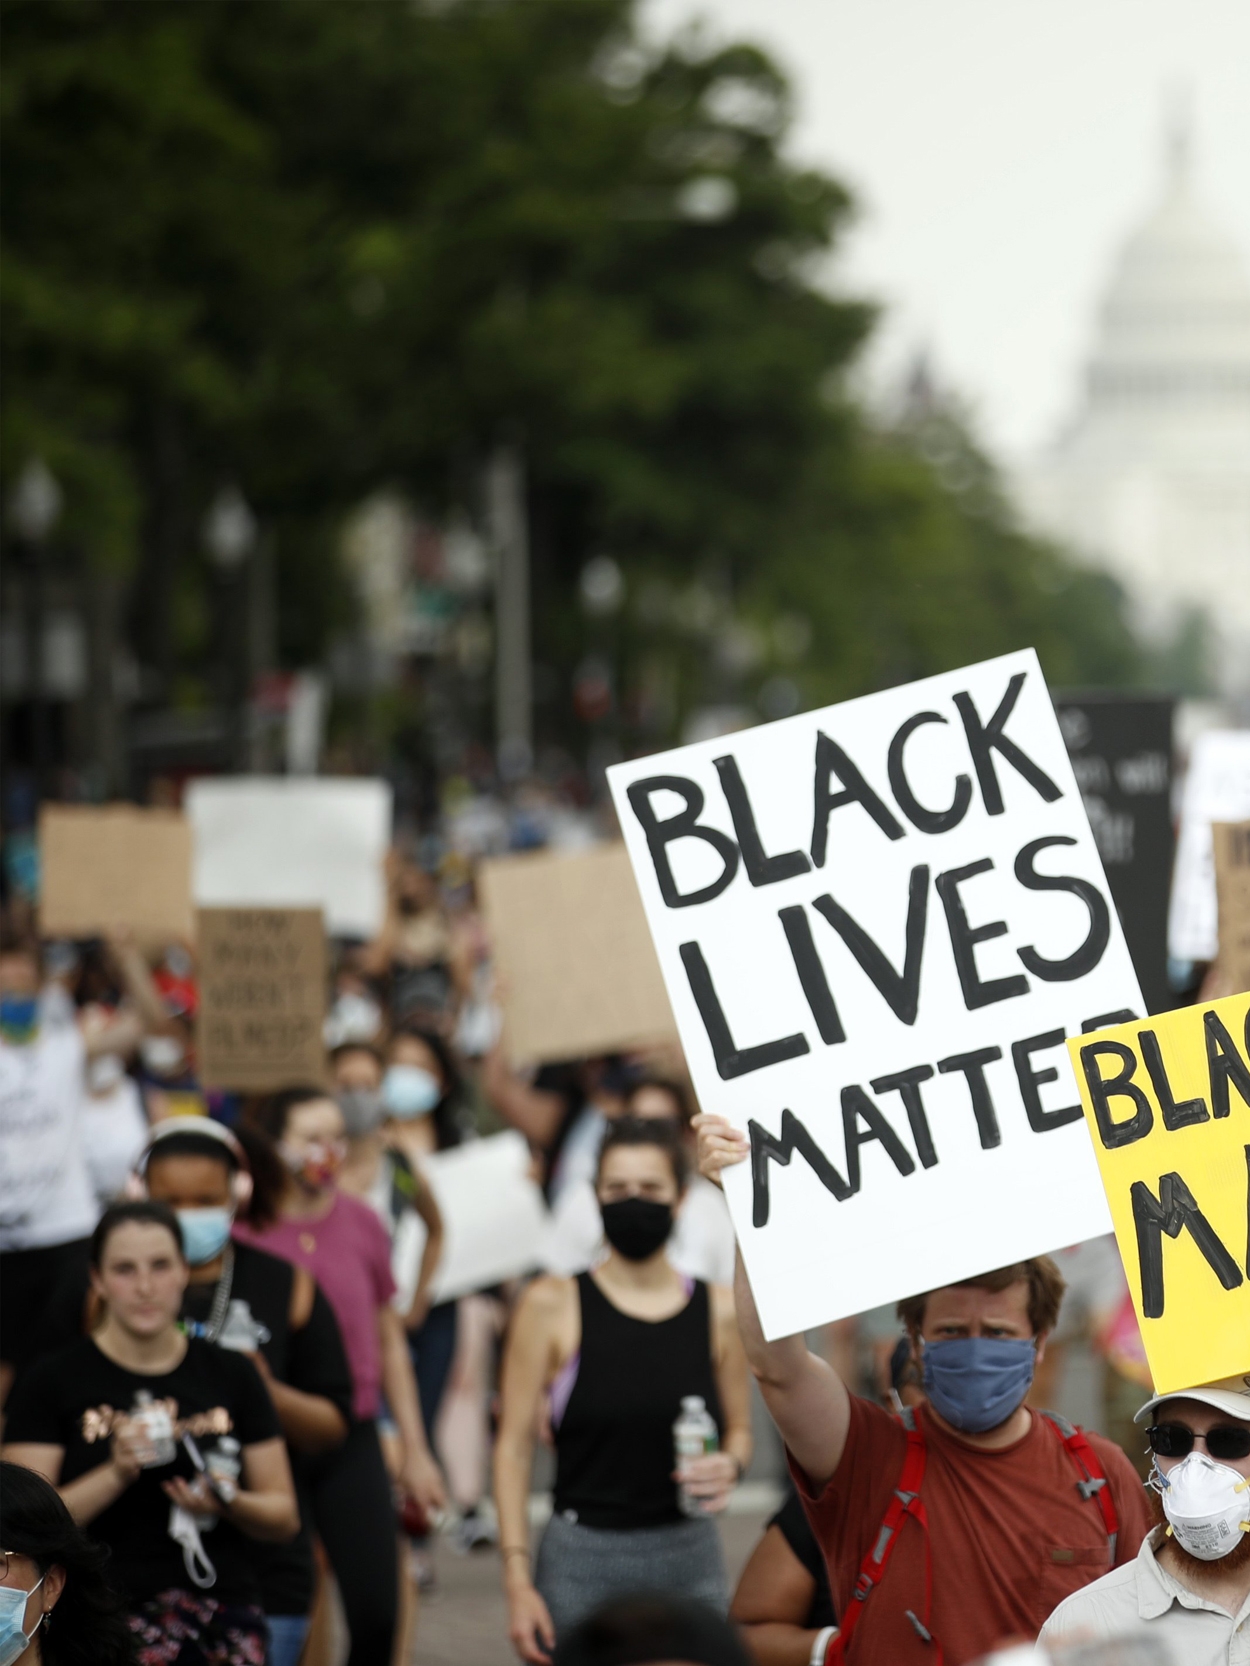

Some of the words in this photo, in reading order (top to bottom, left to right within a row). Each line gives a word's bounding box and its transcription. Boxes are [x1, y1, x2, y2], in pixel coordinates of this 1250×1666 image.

[627, 672, 1064, 908] BLACK
[679, 836, 1111, 1080] LIVES
[748, 1009, 1140, 1228] MATTE
